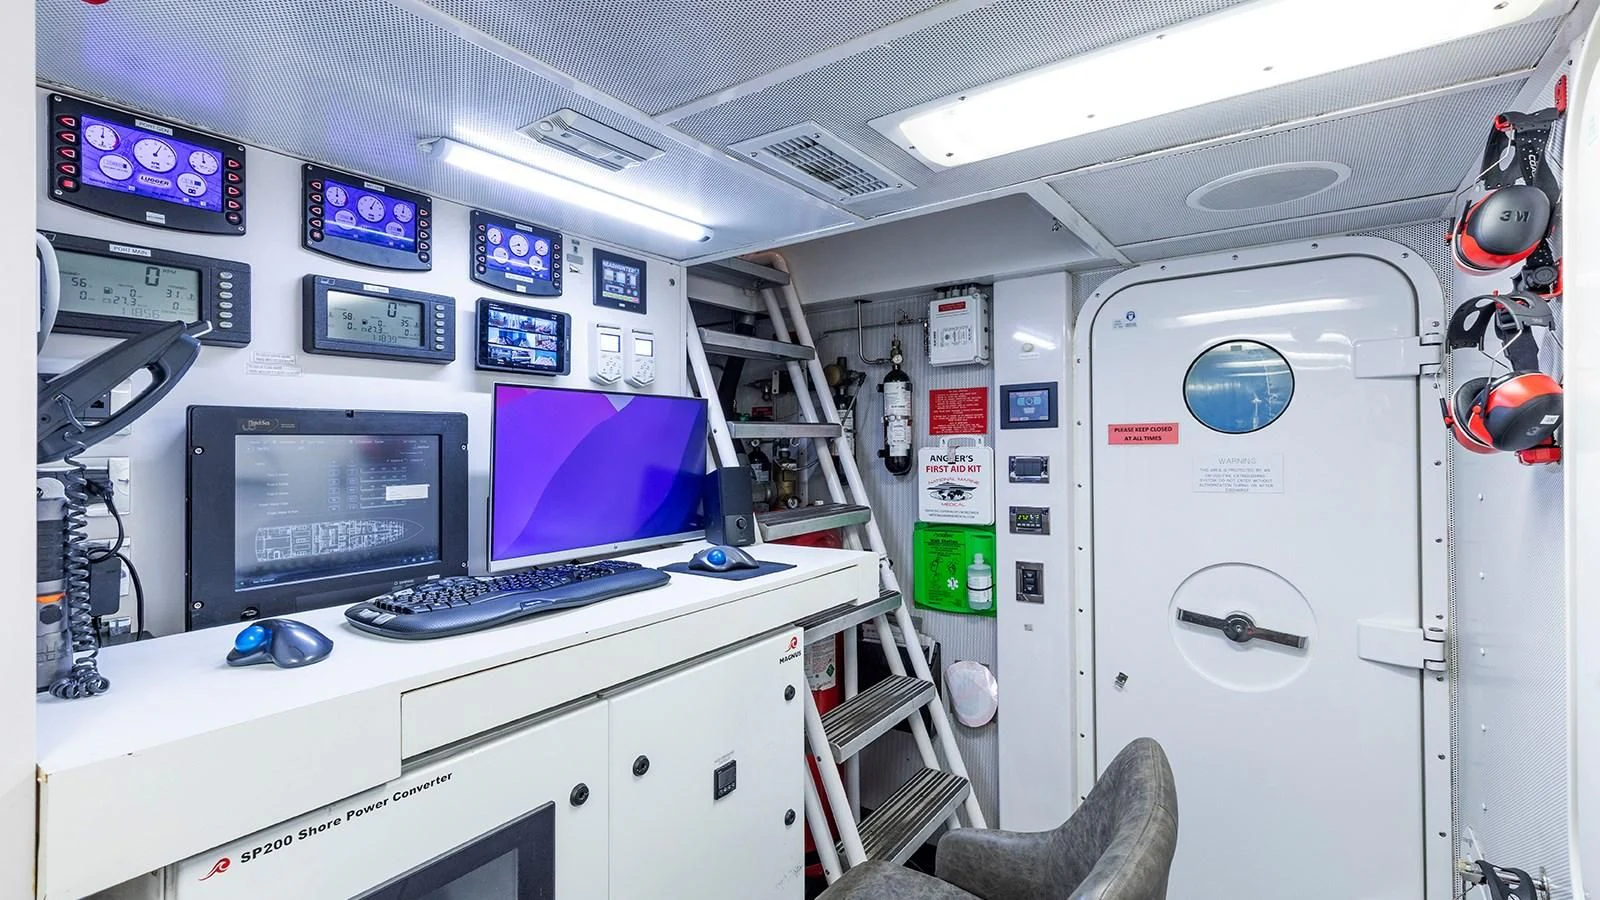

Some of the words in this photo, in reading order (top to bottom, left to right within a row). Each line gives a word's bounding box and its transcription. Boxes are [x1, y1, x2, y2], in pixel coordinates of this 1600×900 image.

[140, 176, 170, 186] LUGGER
[72, 276, 87, 288] 56
[145, 266, 160, 287] 0
[388, 302, 397, 318] 0
[780, 650, 802, 664] MAGNUS
[241, 835, 293, 863] SP200
[298, 818, 341, 840] Shore
[346, 798, 389, 821] Power
[393, 773, 452, 801] Converter
